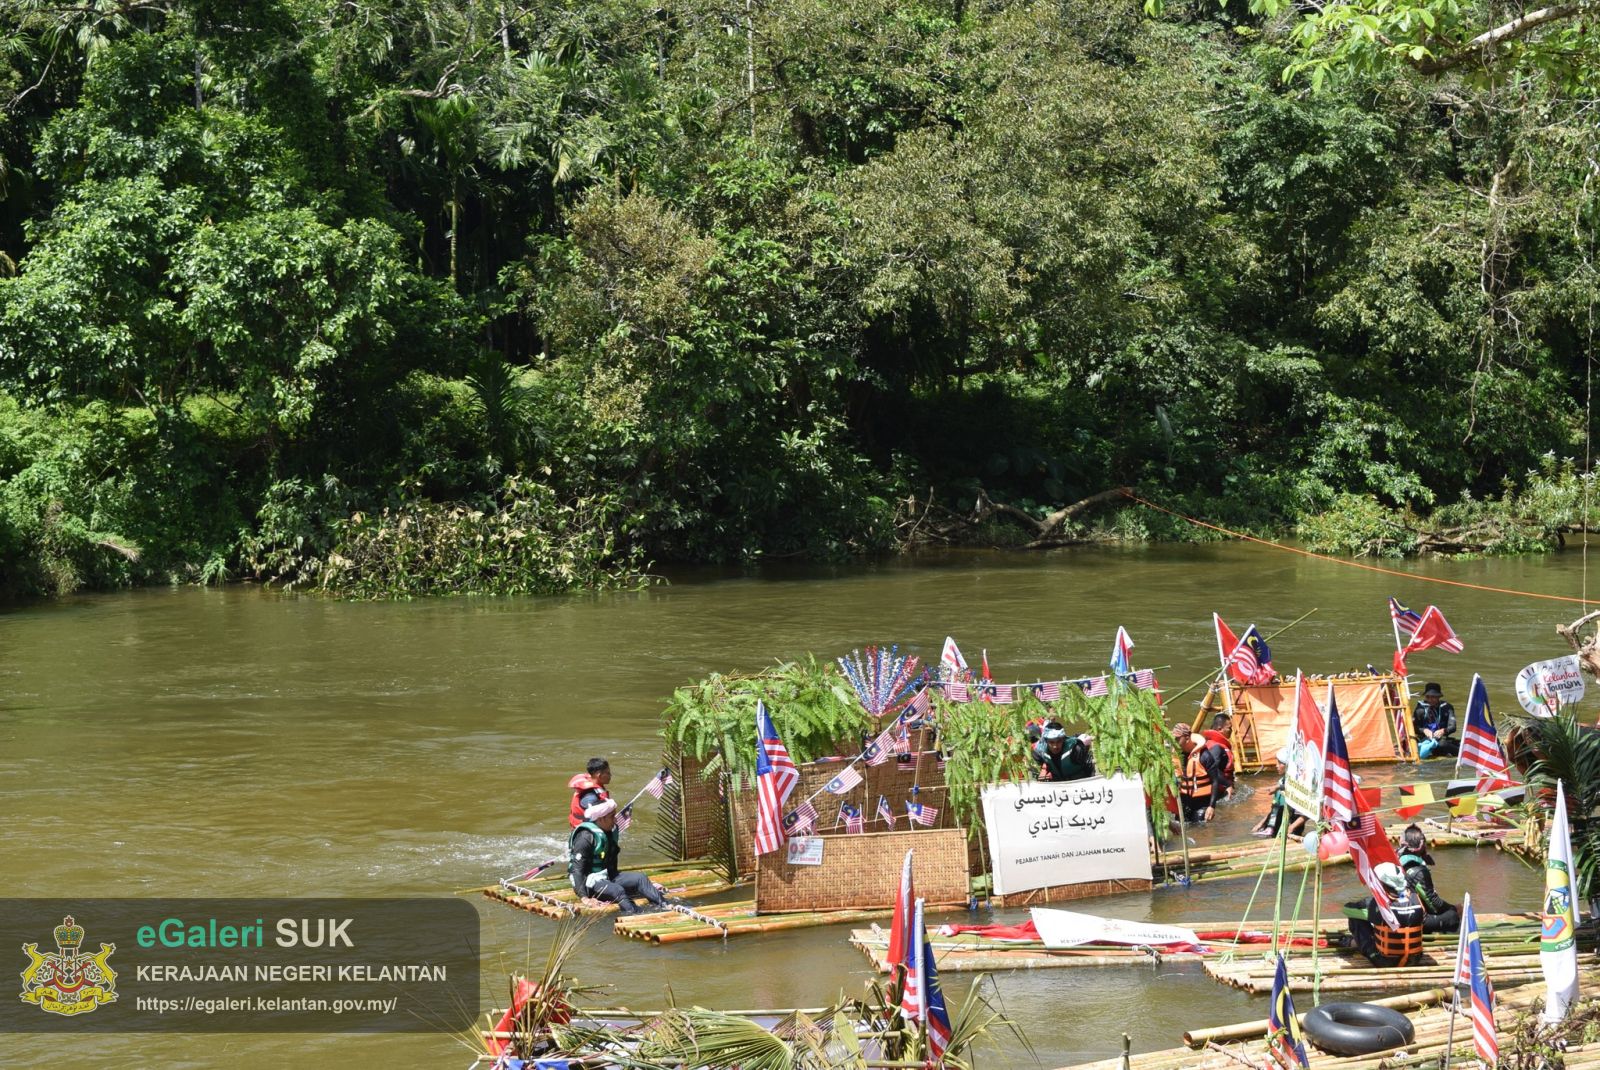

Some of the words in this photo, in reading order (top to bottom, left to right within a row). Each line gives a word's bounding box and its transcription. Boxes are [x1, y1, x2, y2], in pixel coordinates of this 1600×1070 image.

[1543, 671, 1579, 683] Kelantan
[1547, 680, 1582, 692] Tourism
[1015, 857, 1040, 865] PEJABAT
[1040, 853, 1060, 861] TANAH
[1061, 851, 1074, 859] DAN
[1075, 849, 1102, 857] JAJAHAN
[1102, 847, 1126, 855] BACHOK
